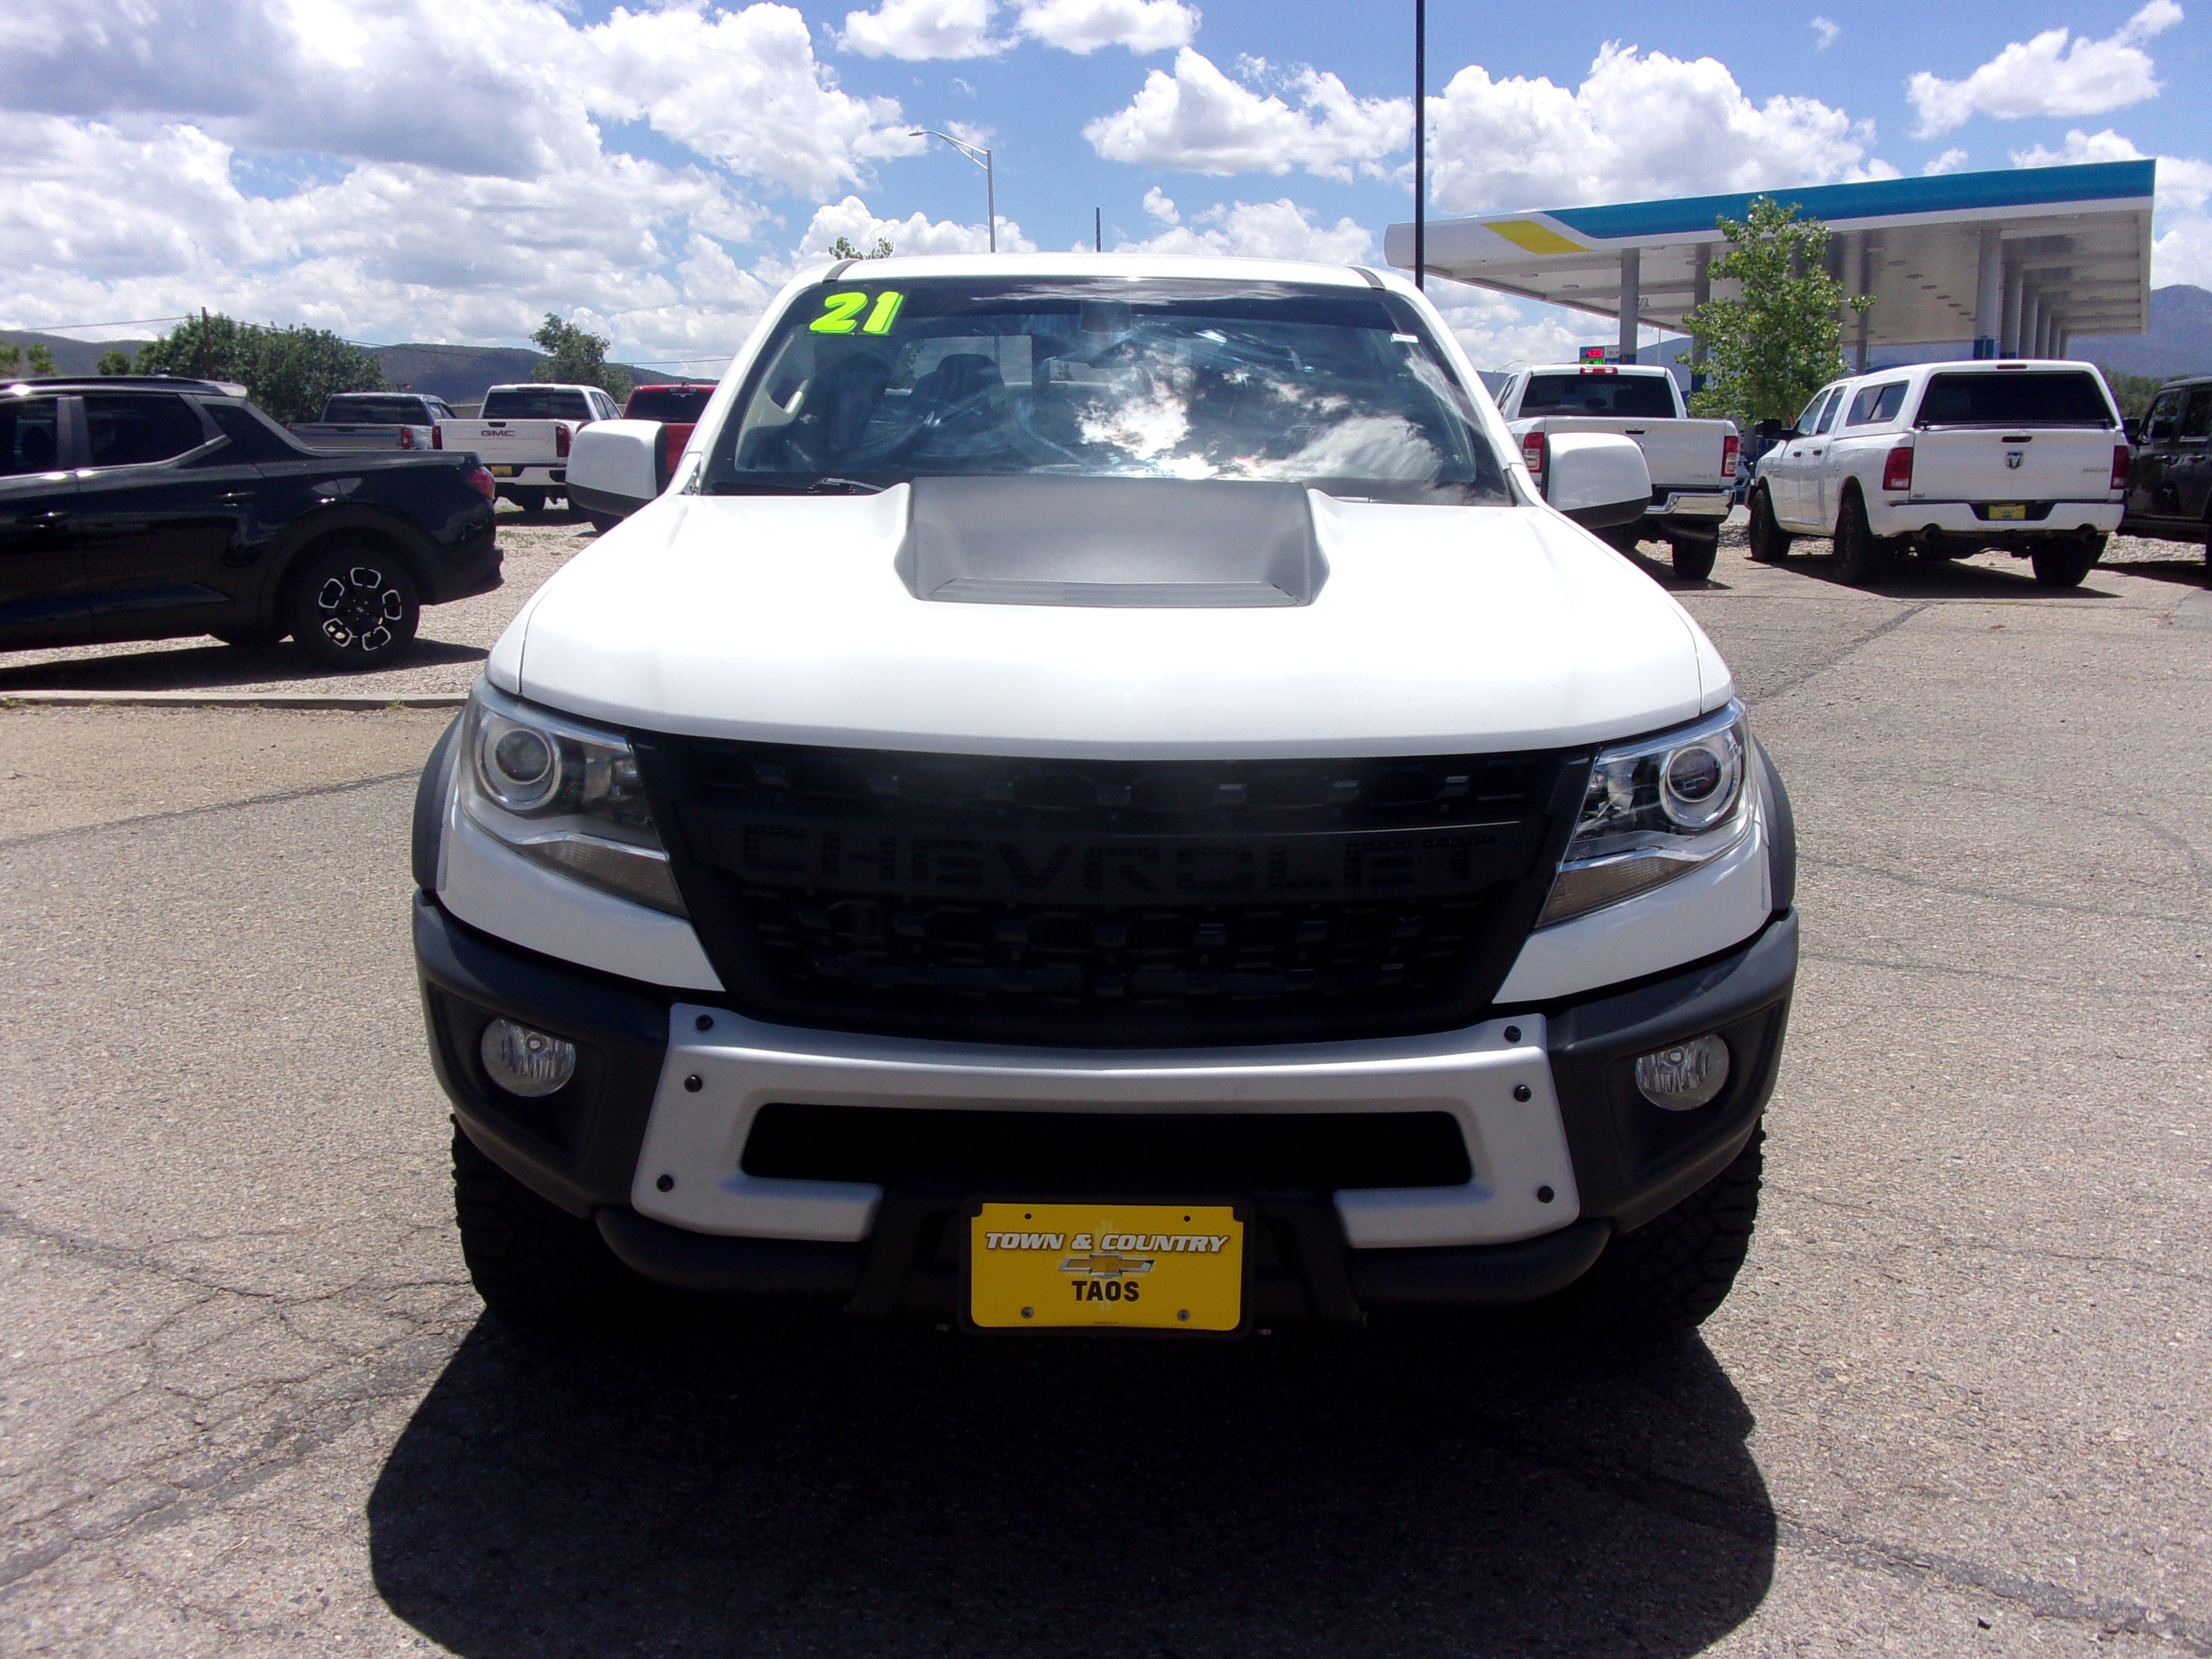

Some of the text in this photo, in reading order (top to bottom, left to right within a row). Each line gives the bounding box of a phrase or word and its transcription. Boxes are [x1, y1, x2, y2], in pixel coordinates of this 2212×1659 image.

[809, 291, 904, 334] 21
[743, 824, 1496, 892] CHEVROLET
[985, 1232, 1231, 1253] TOWN & COUNTRY
[1071, 1280, 1140, 1301] TAOS
